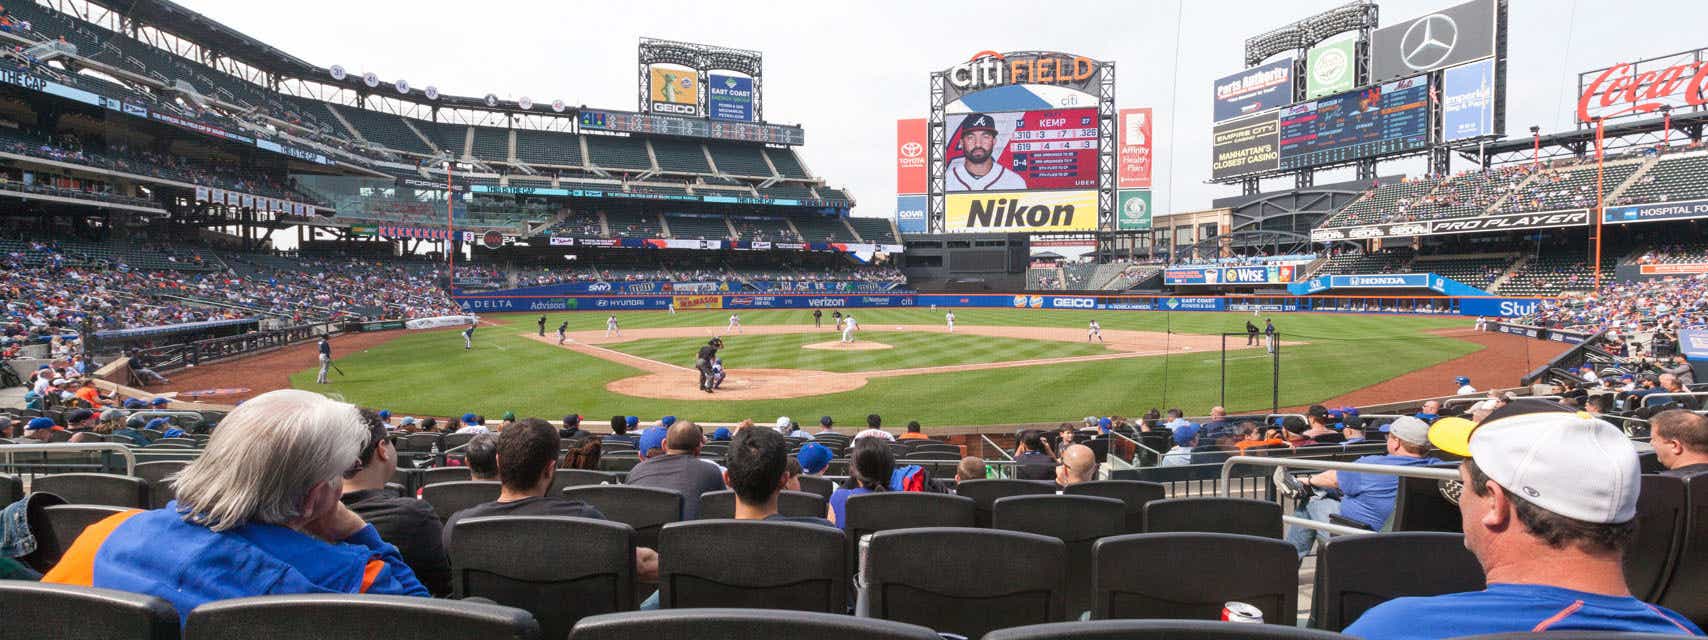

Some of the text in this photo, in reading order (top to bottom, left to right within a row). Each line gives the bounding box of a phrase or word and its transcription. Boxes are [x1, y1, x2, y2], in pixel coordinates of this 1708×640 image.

[951, 54, 1093, 87] citi FIELD
[1, 70, 47, 92] THE CAP
[653, 102, 695, 114] GEICO
[1040, 118, 1066, 128] KEMP
[1217, 130, 1251, 142] EMPIRE
[1219, 144, 1272, 161] MANHATTAN'S
[1213, 157, 1246, 170] CLOSEST
[1247, 151, 1278, 164] CASINO
[966, 198, 1075, 228] Nikon
[1639, 206, 1692, 217] HOSPITAL
[1433, 212, 1586, 231] PRO PLAYER
[1238, 268, 1265, 282] WISE
[474, 300, 513, 308] DELTA
[530, 301, 566, 310] Advisors
[808, 297, 845, 306] verizon
[1053, 298, 1094, 308] GEICO
